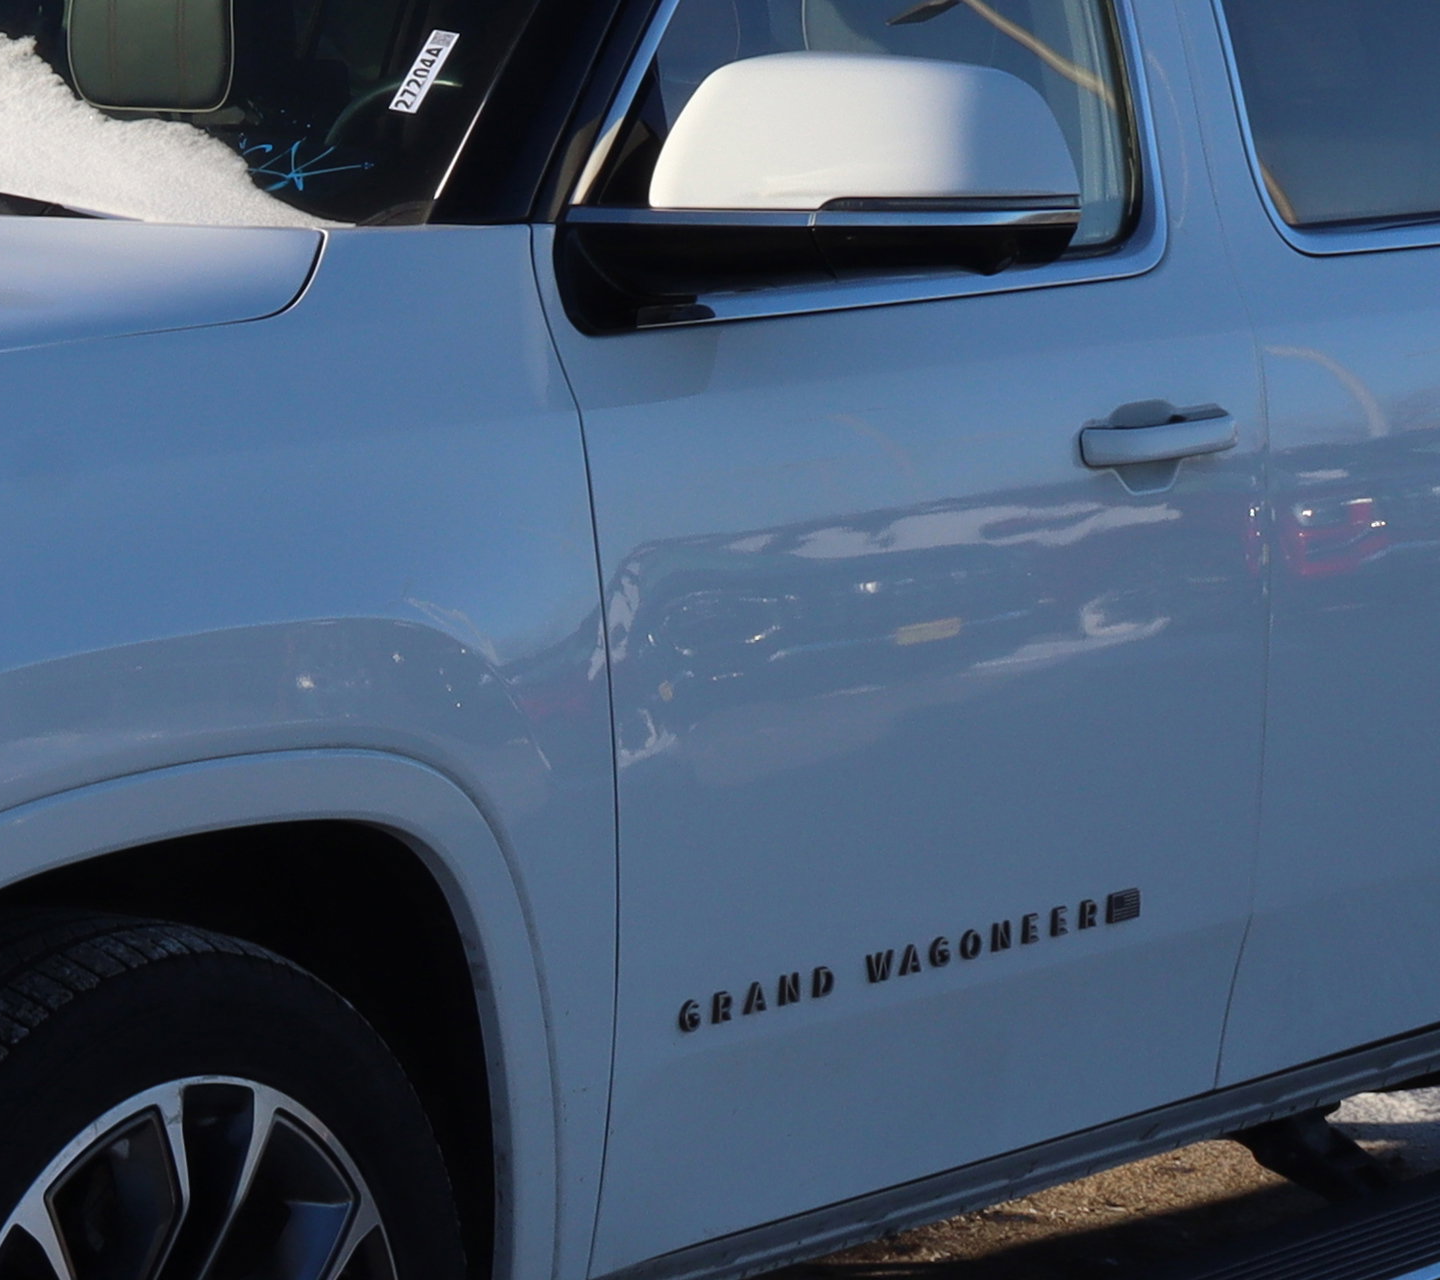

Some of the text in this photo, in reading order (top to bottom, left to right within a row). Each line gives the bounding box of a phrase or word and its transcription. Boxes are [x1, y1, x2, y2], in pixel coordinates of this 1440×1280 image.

[394, 47, 444, 110] 27204A
[677, 899, 1098, 1033] GRAND WAGONEER
